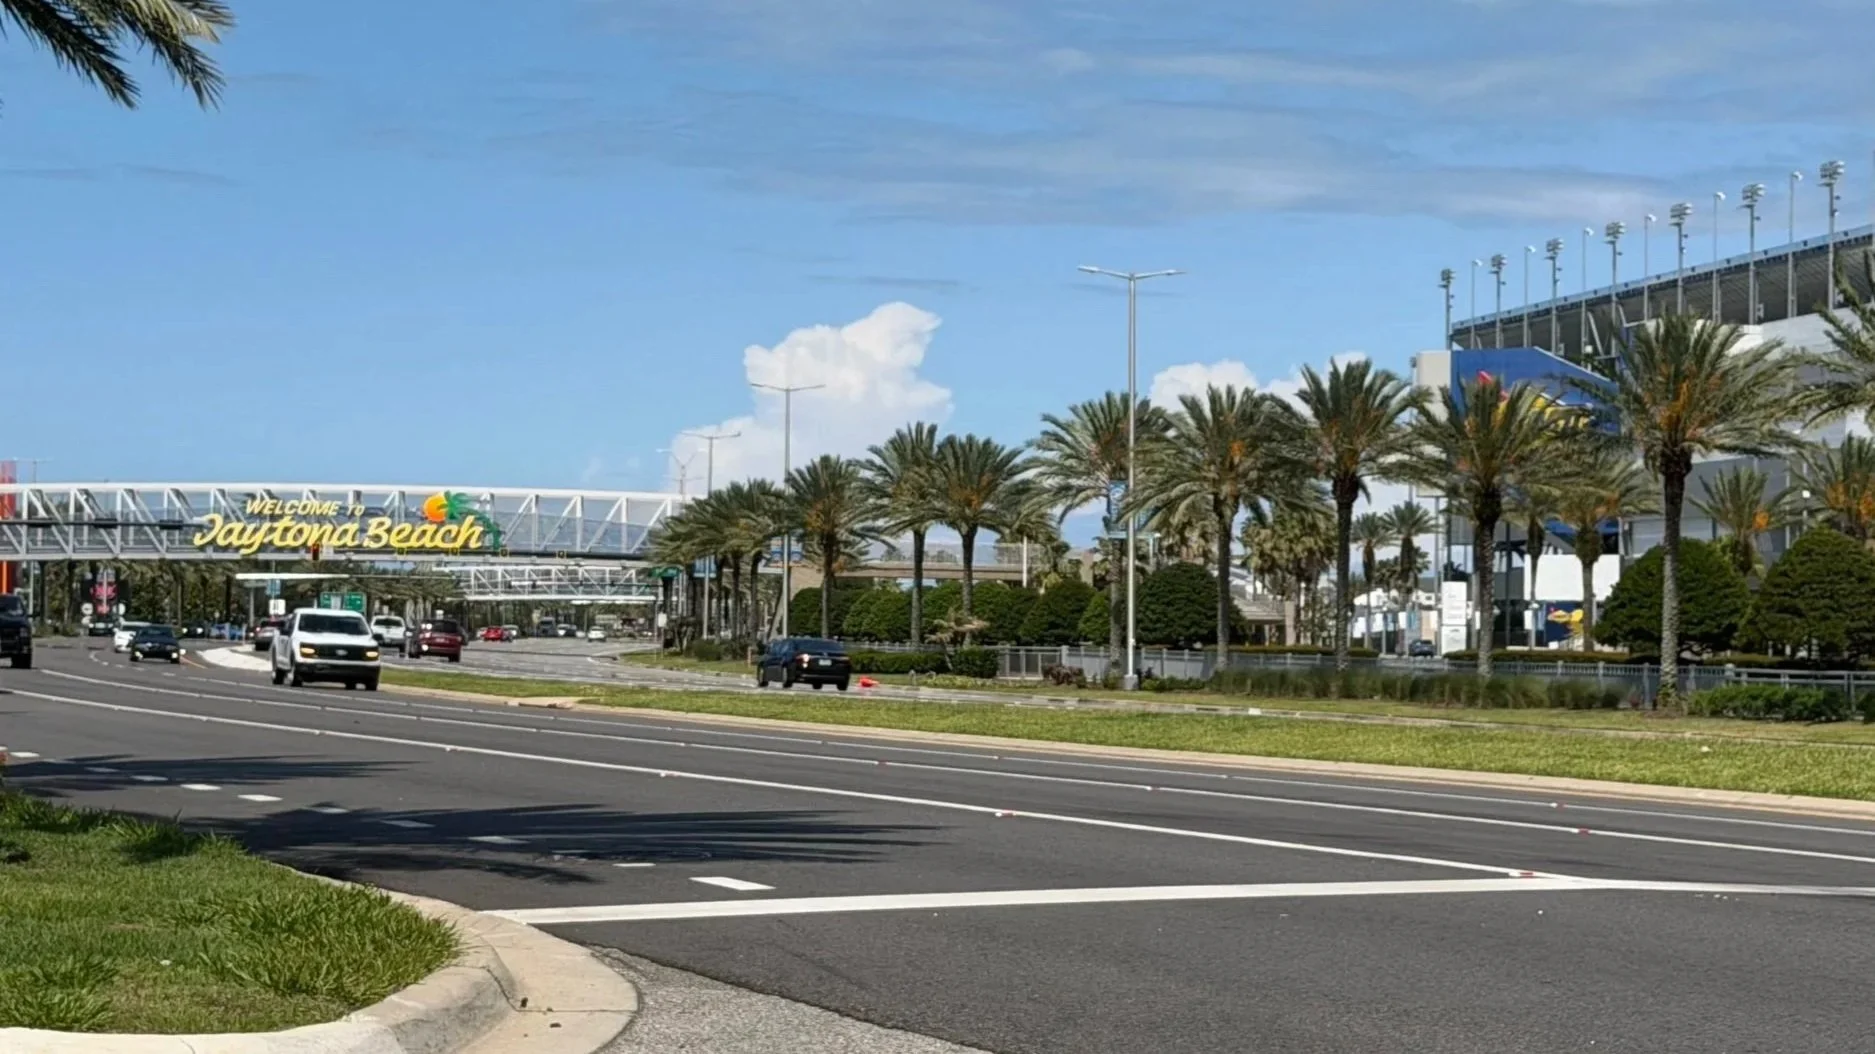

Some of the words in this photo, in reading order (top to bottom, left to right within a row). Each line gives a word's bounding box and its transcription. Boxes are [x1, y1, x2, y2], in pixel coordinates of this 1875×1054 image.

[246, 499, 342, 516] WELCOME
[346, 504, 366, 517] TO
[193, 513, 361, 556] Daytona
[363, 515, 484, 548] Beach
